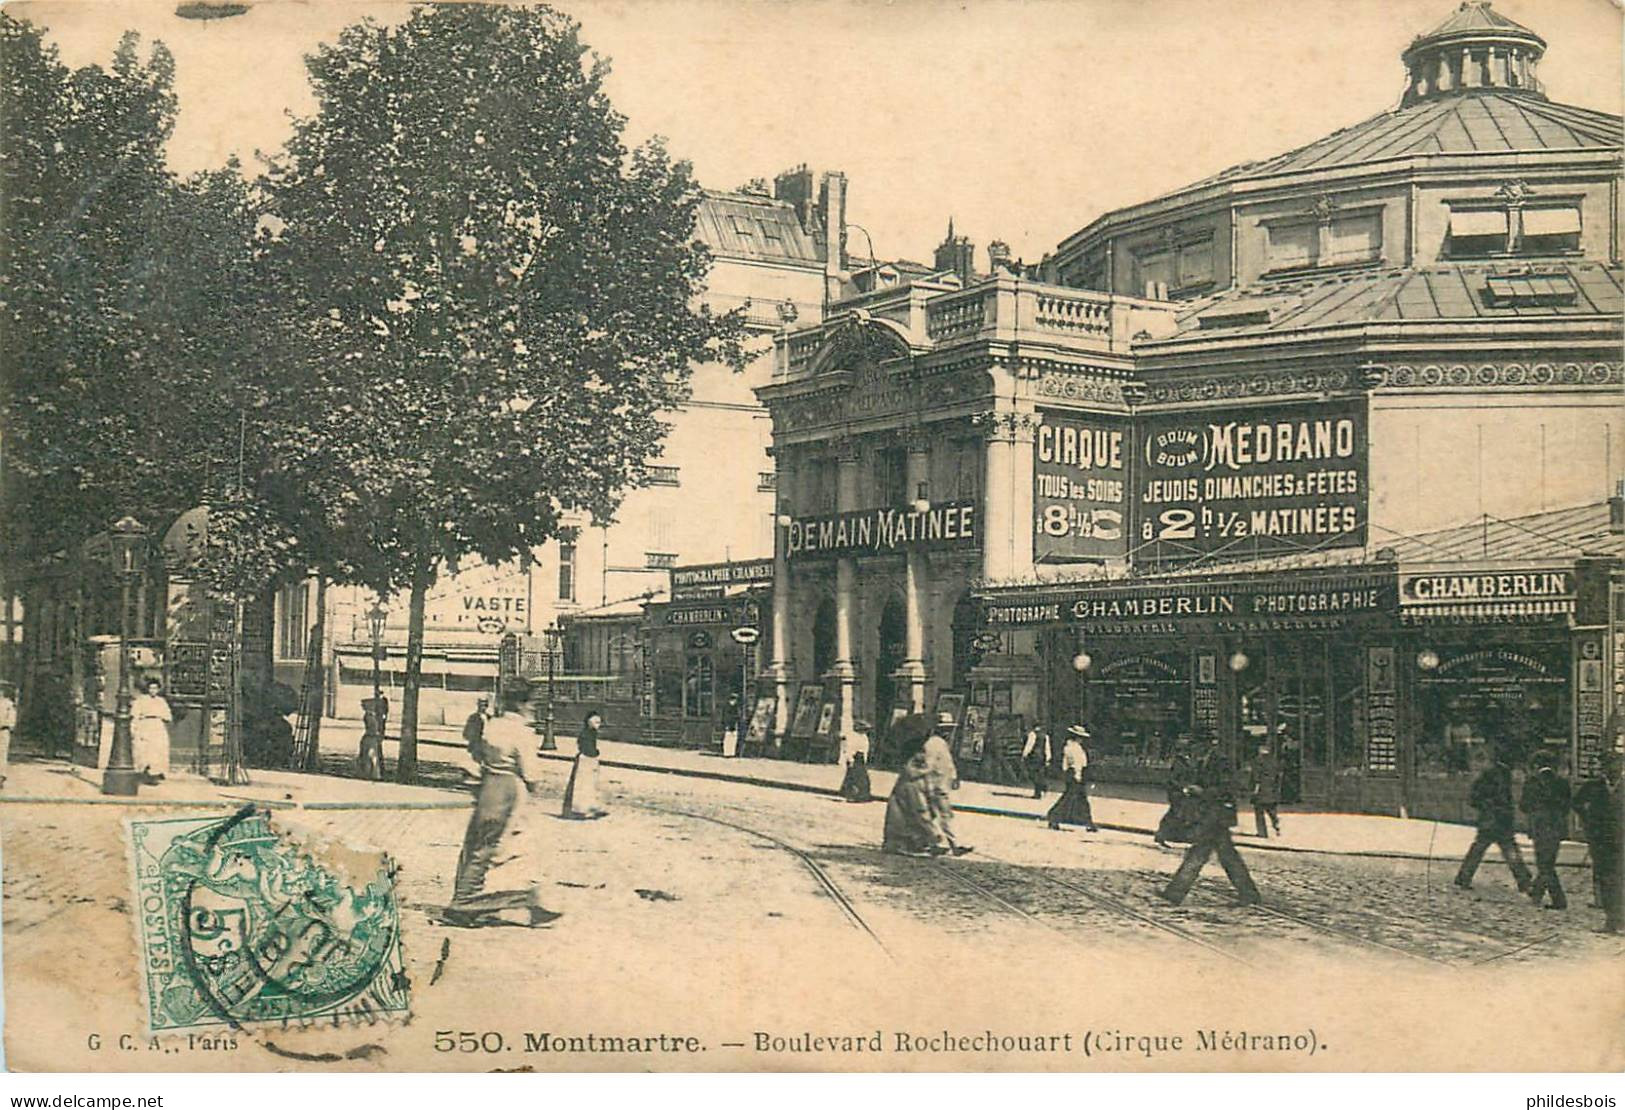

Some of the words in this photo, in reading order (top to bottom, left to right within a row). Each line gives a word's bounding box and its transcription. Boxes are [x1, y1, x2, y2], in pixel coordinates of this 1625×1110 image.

[1039, 424, 1122, 470] CIRQUE
[1038, 473, 1068, 499] TOUS
[1070, 480, 1085, 499] les
[1087, 478, 1123, 503] SOIRS
[1143, 478, 1203, 503] JEUDIS,
[1205, 474, 1294, 500] DIMANCHES
[786, 516, 871, 558] DEMAIN
[875, 502, 975, 549] MATINÉE
[1251, 503, 1357, 536] MATINÉES
[1415, 574, 1567, 598] CHAMBERLIN
[463, 596, 526, 611] VASTE
[986, 604, 1061, 623] PHOTOGRAPHIE
[1071, 594, 1235, 618] CHAMBERLIN
[1253, 590, 1378, 613] PHOTOGRAPHIE
[433, 1031, 512, 1053] 550.
[524, 1032, 707, 1053] Montmartre.
[754, 1031, 883, 1053] Boulevard
[895, 1031, 1073, 1053] Rochechouart
[1196, 1030, 1329, 1056] Médrano).
